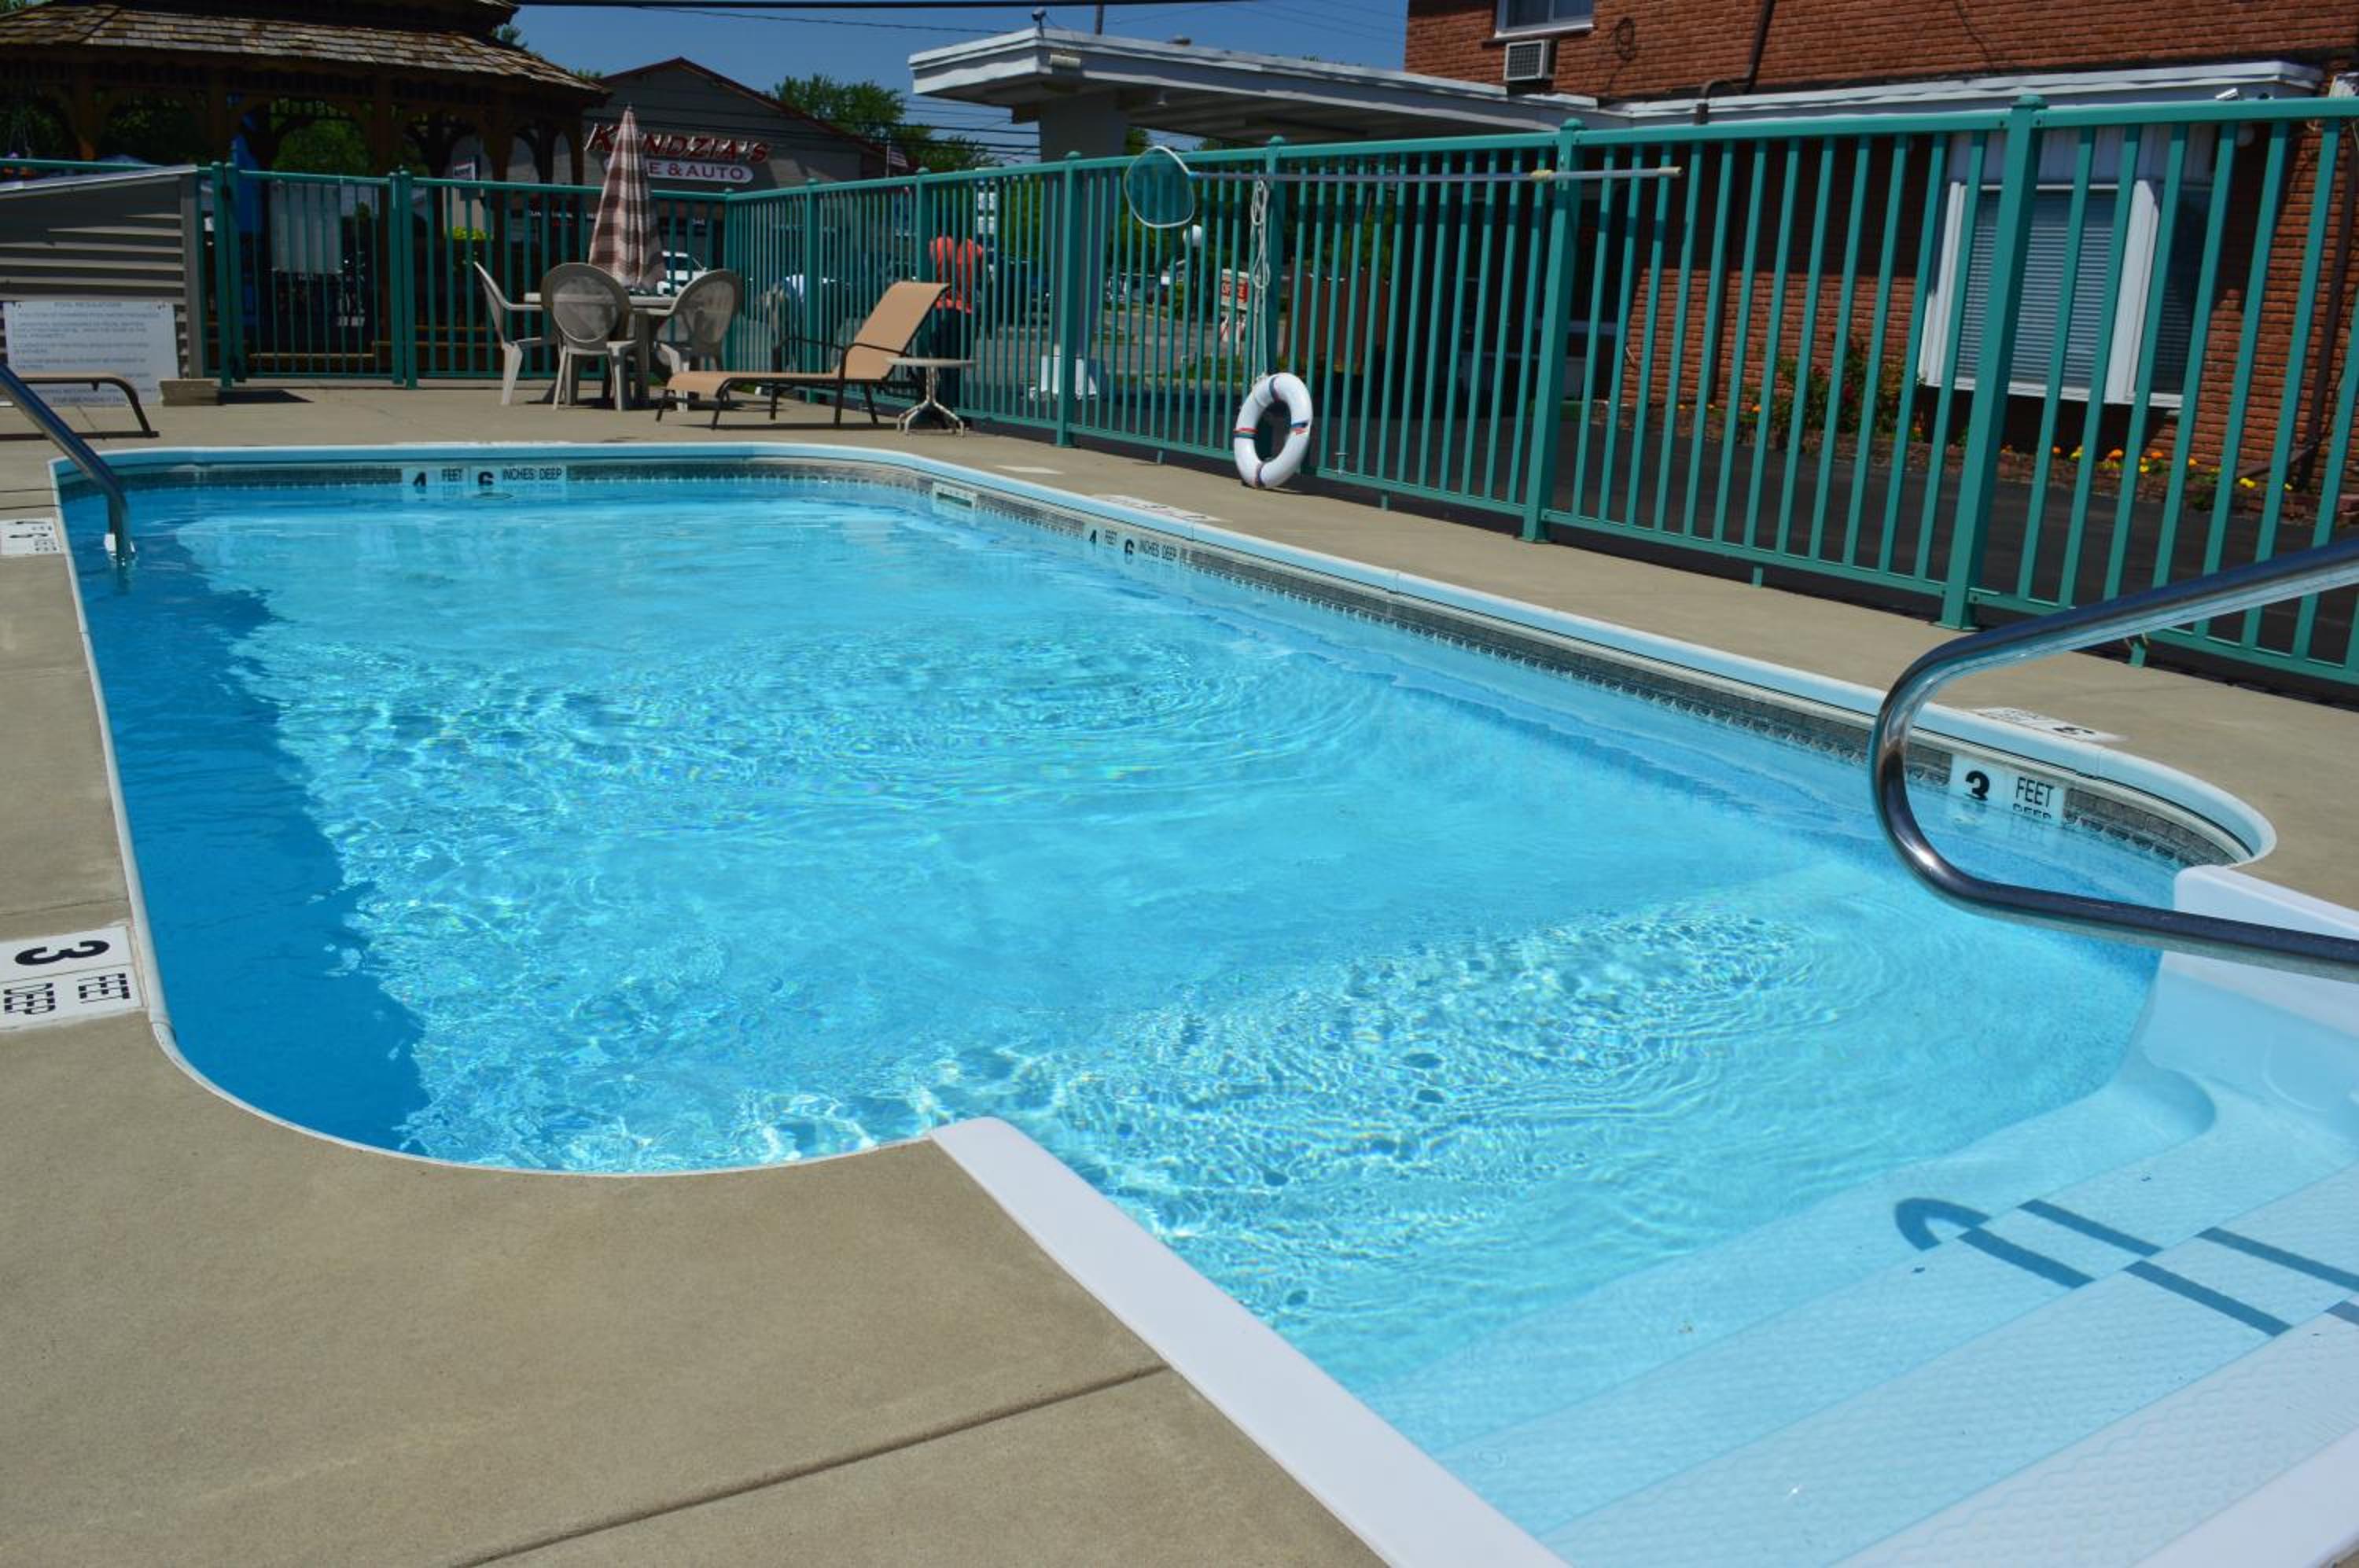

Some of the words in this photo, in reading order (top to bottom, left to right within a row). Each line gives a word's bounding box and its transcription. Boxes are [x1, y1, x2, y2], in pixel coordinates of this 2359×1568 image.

[583, 123, 771, 163] KNDZIA'S
[412, 472, 427, 487] 4
[442, 468, 463, 481] FEET
[503, 468, 535, 480] INCHES
[539, 468, 562, 480] DEEP
[2015, 776, 2055, 808] FEET
[14, 940, 111, 966] 3
[3, 982, 56, 1015] DEEP
[76, 973, 131, 1003] FEET
